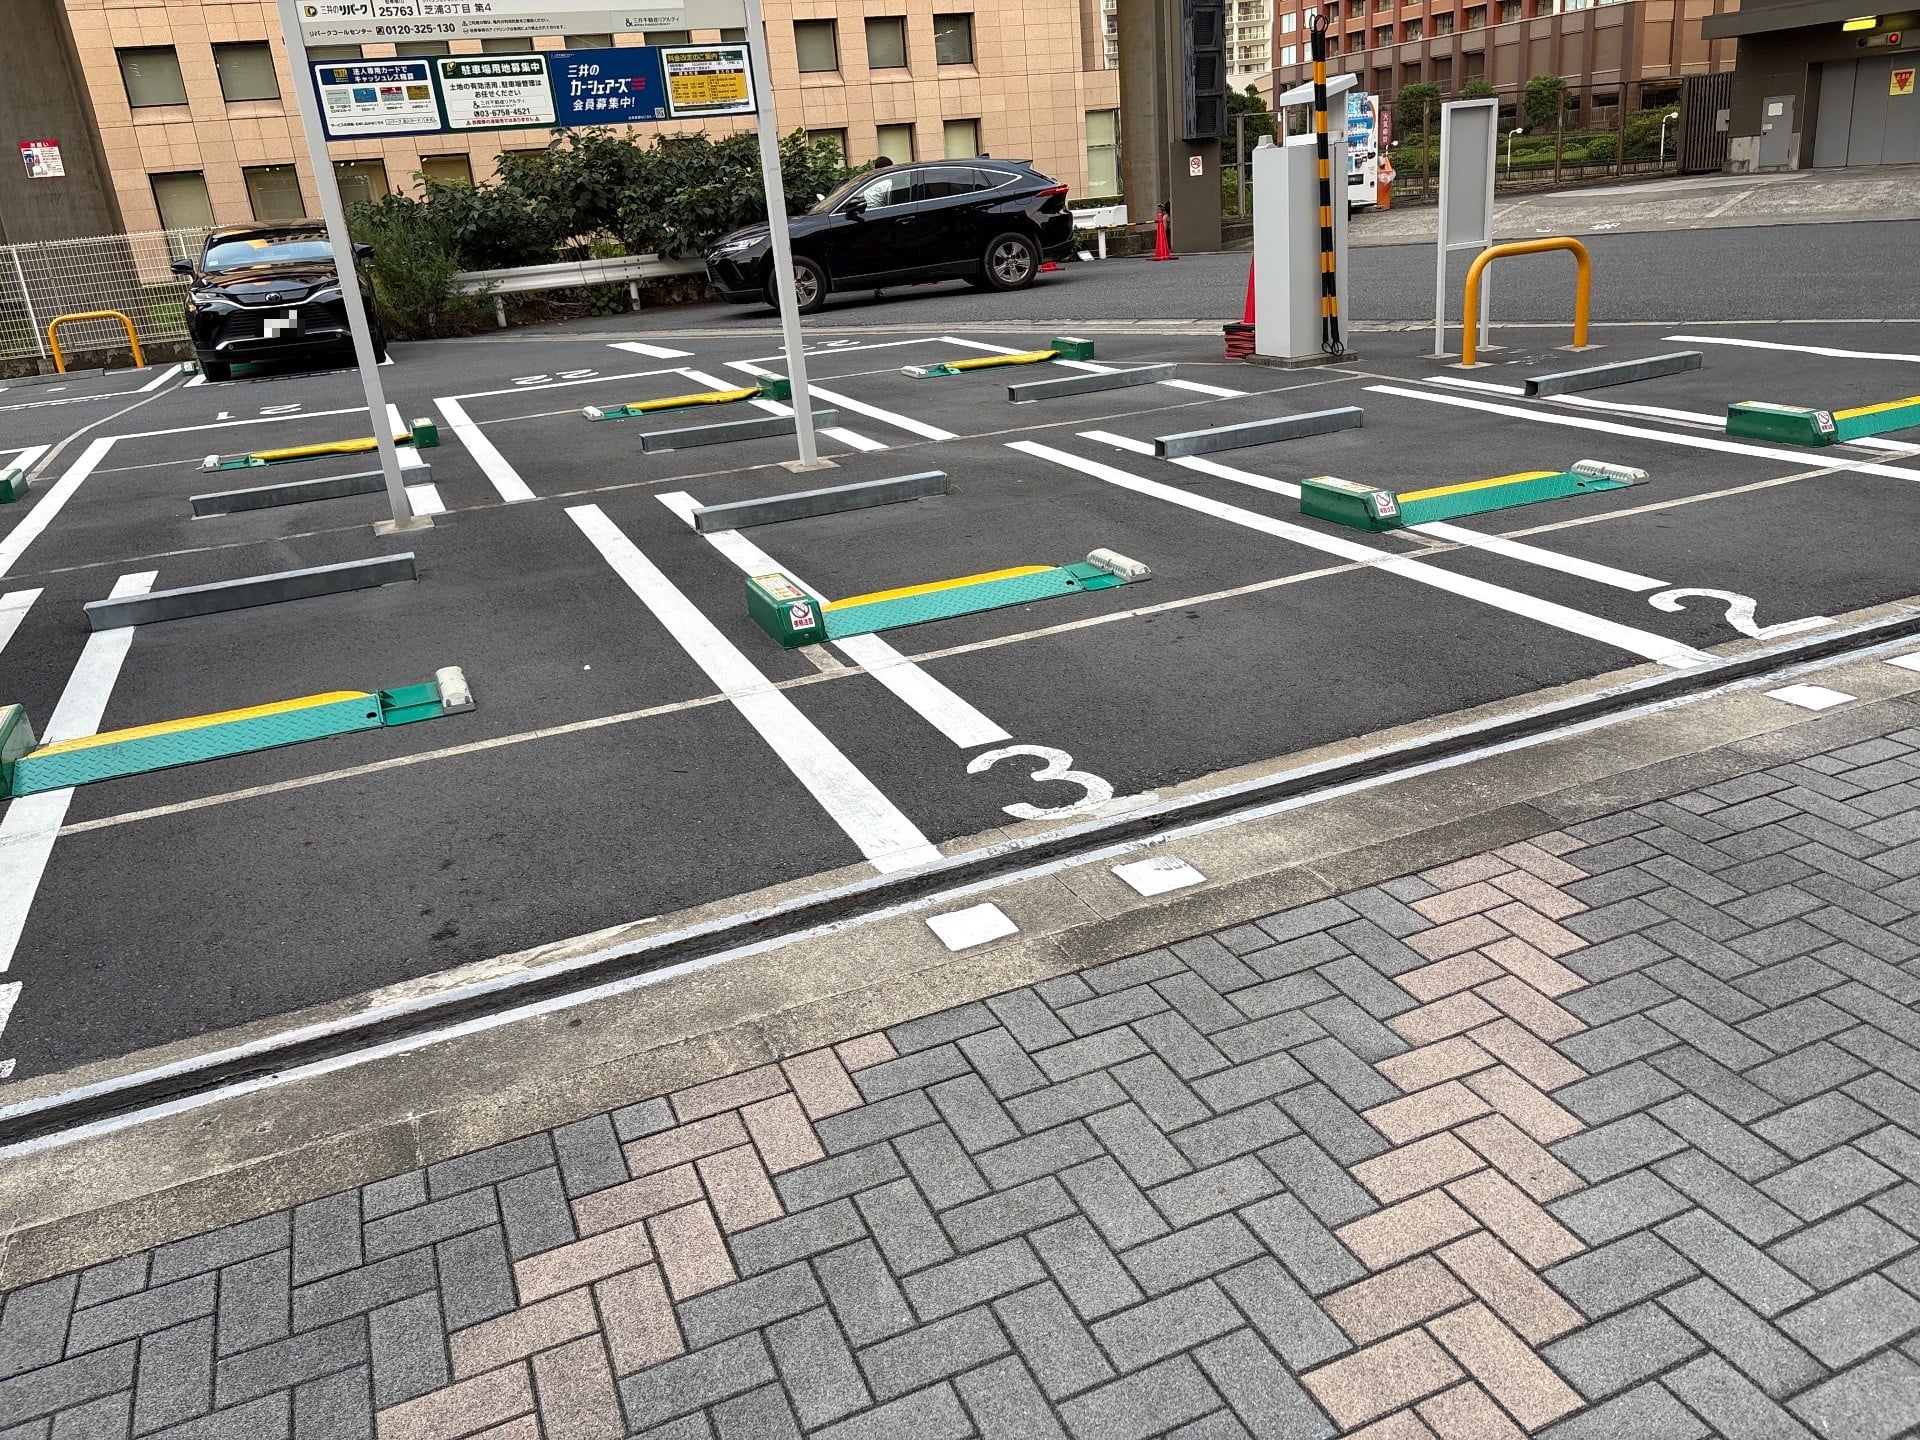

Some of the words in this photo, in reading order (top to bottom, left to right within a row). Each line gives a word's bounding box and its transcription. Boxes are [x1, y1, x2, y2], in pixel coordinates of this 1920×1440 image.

[321, 5, 368, 15] 三井のリパーク
[379, 6, 414, 17] 25763
[424, 4, 471, 15] 芝浦3丁目
[474, 3, 492, 13] 第4
[309, 29, 372, 37] リパークコールセンター
[385, 23, 456, 35] 0120-325-130
[461, 62, 540, 76] 駐車場用地募集中
[567, 64, 600, 78] 三井の
[449, 80, 543, 91] 土地の有効活用、駐車場管理は
[570, 78, 632, 96] カーシェアーズ
[474, 90, 522, 98] お任せください
[573, 97, 636, 111] 会員募集中!
[480, 108, 530, 117] 03-6758-4521
[1648, 587, 1836, 641] 2
[966, 744, 1114, 821] 3
